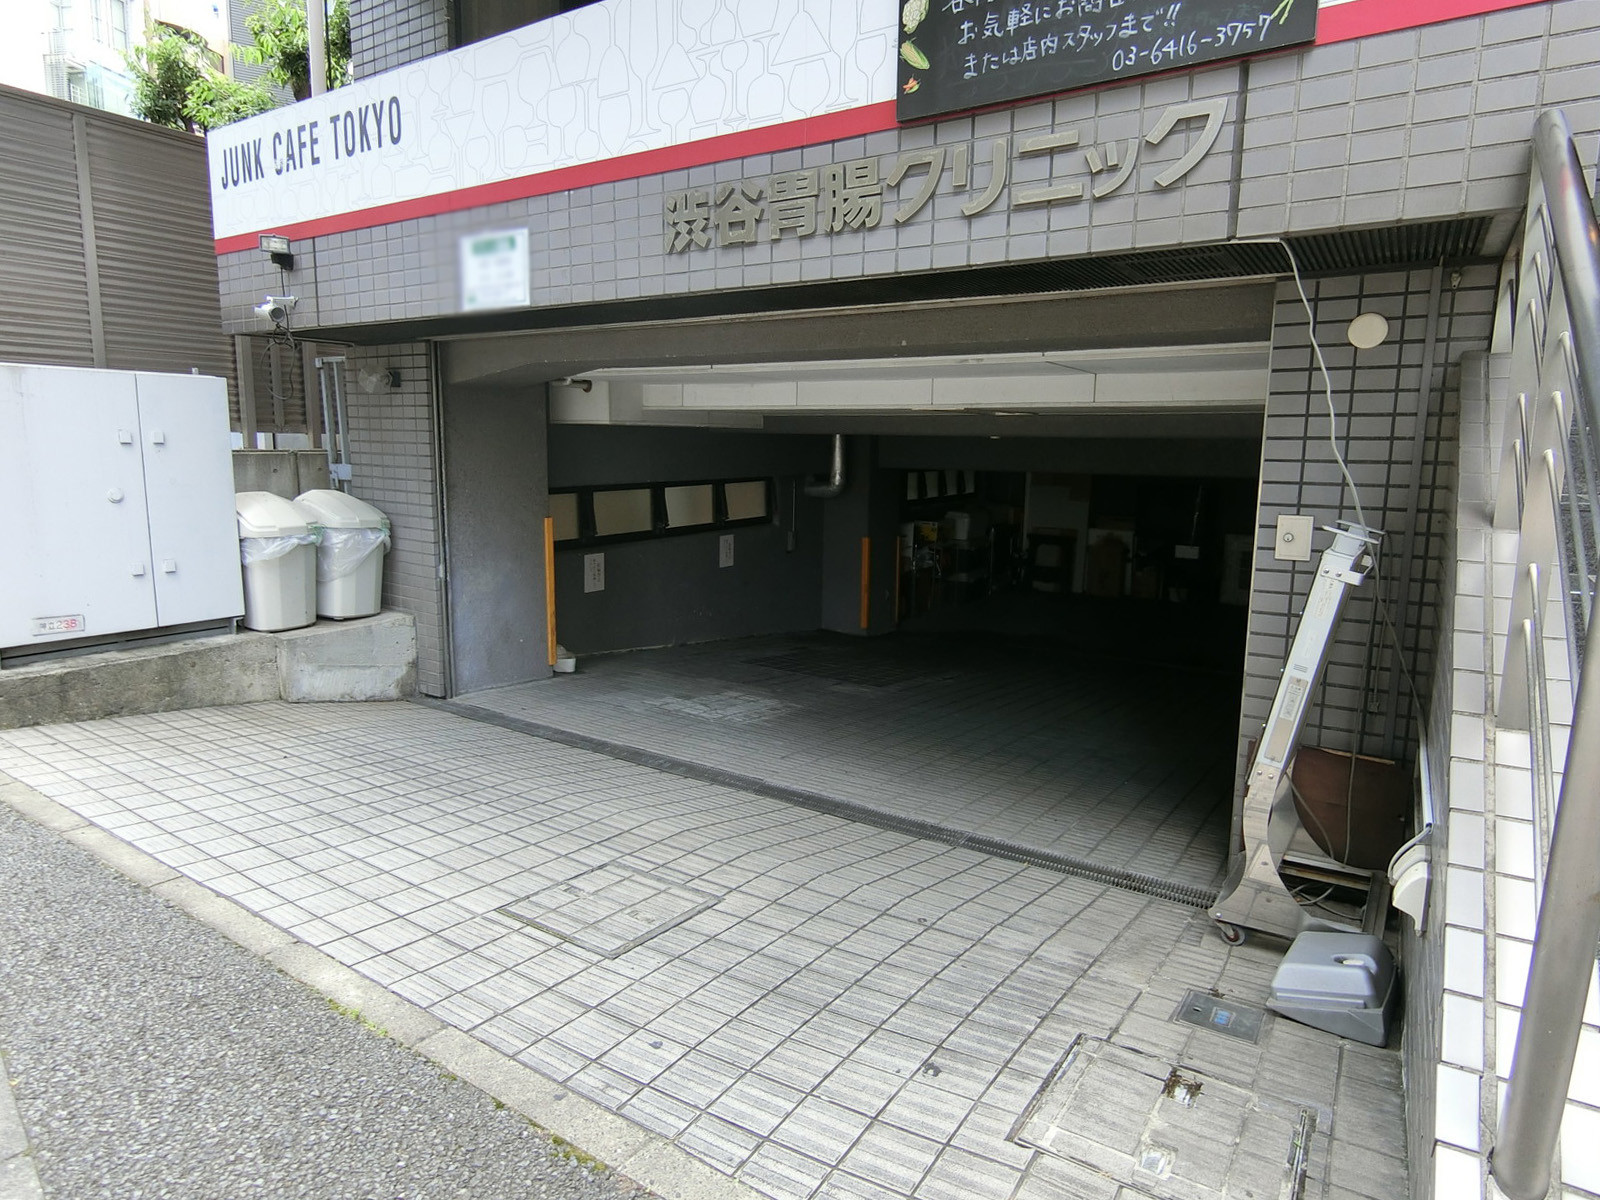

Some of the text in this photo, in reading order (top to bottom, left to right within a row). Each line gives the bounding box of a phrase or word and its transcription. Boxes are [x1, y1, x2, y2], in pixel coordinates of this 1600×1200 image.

[1111, 13, 1273, 72] 03-6416-3757
[221, 95, 402, 190] JUNK CAFE TOKYO
[664, 97, 1228, 253] 渋谷胃腸クリニック
